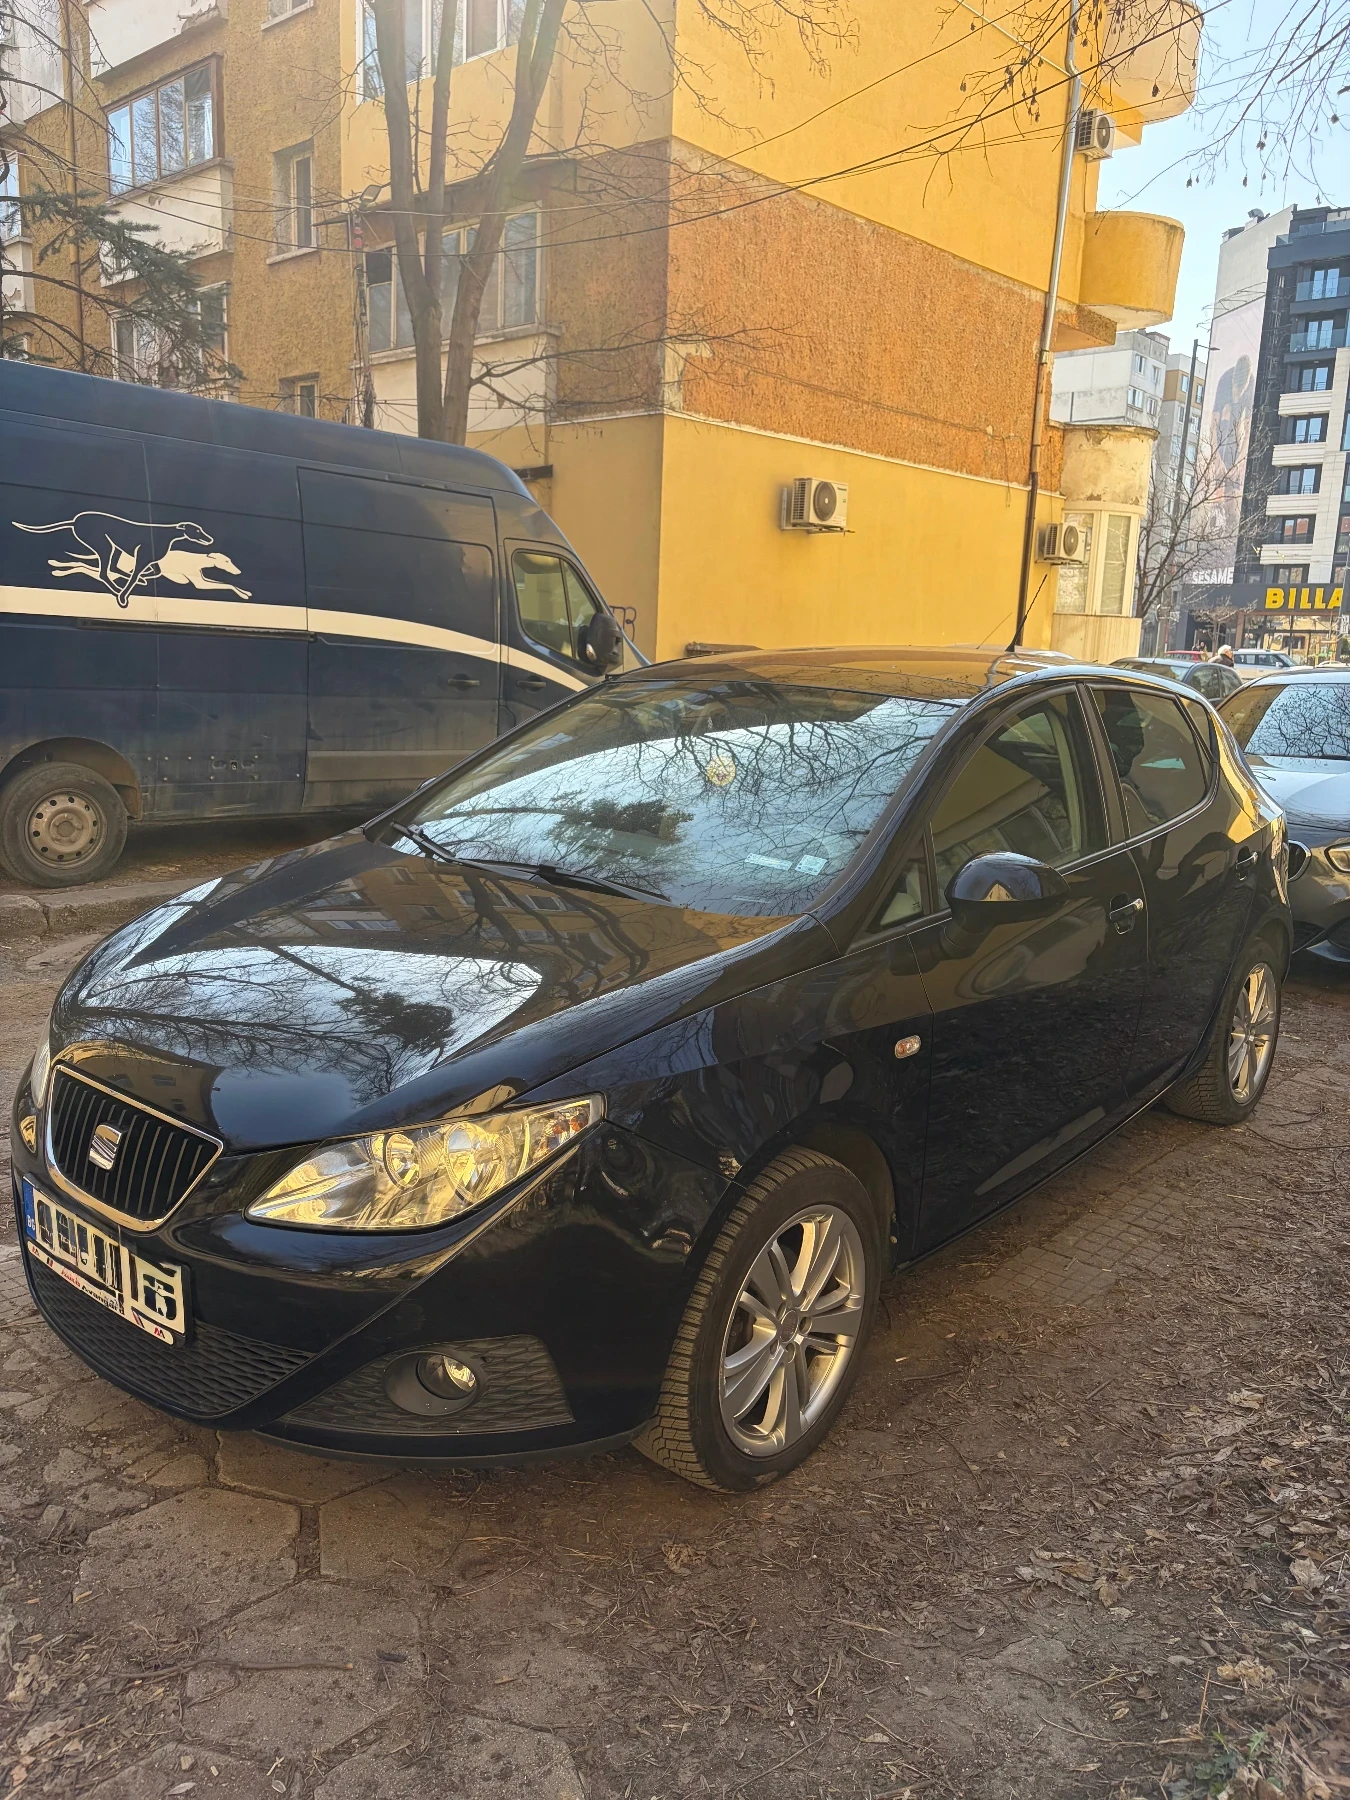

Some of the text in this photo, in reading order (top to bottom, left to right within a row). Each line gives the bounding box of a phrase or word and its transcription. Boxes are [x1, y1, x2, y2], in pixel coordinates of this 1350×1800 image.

[1191, 567, 1235, 584] SESAME
[1265, 587, 1344, 609] BILLA
[27, 1214, 36, 1231] BG
